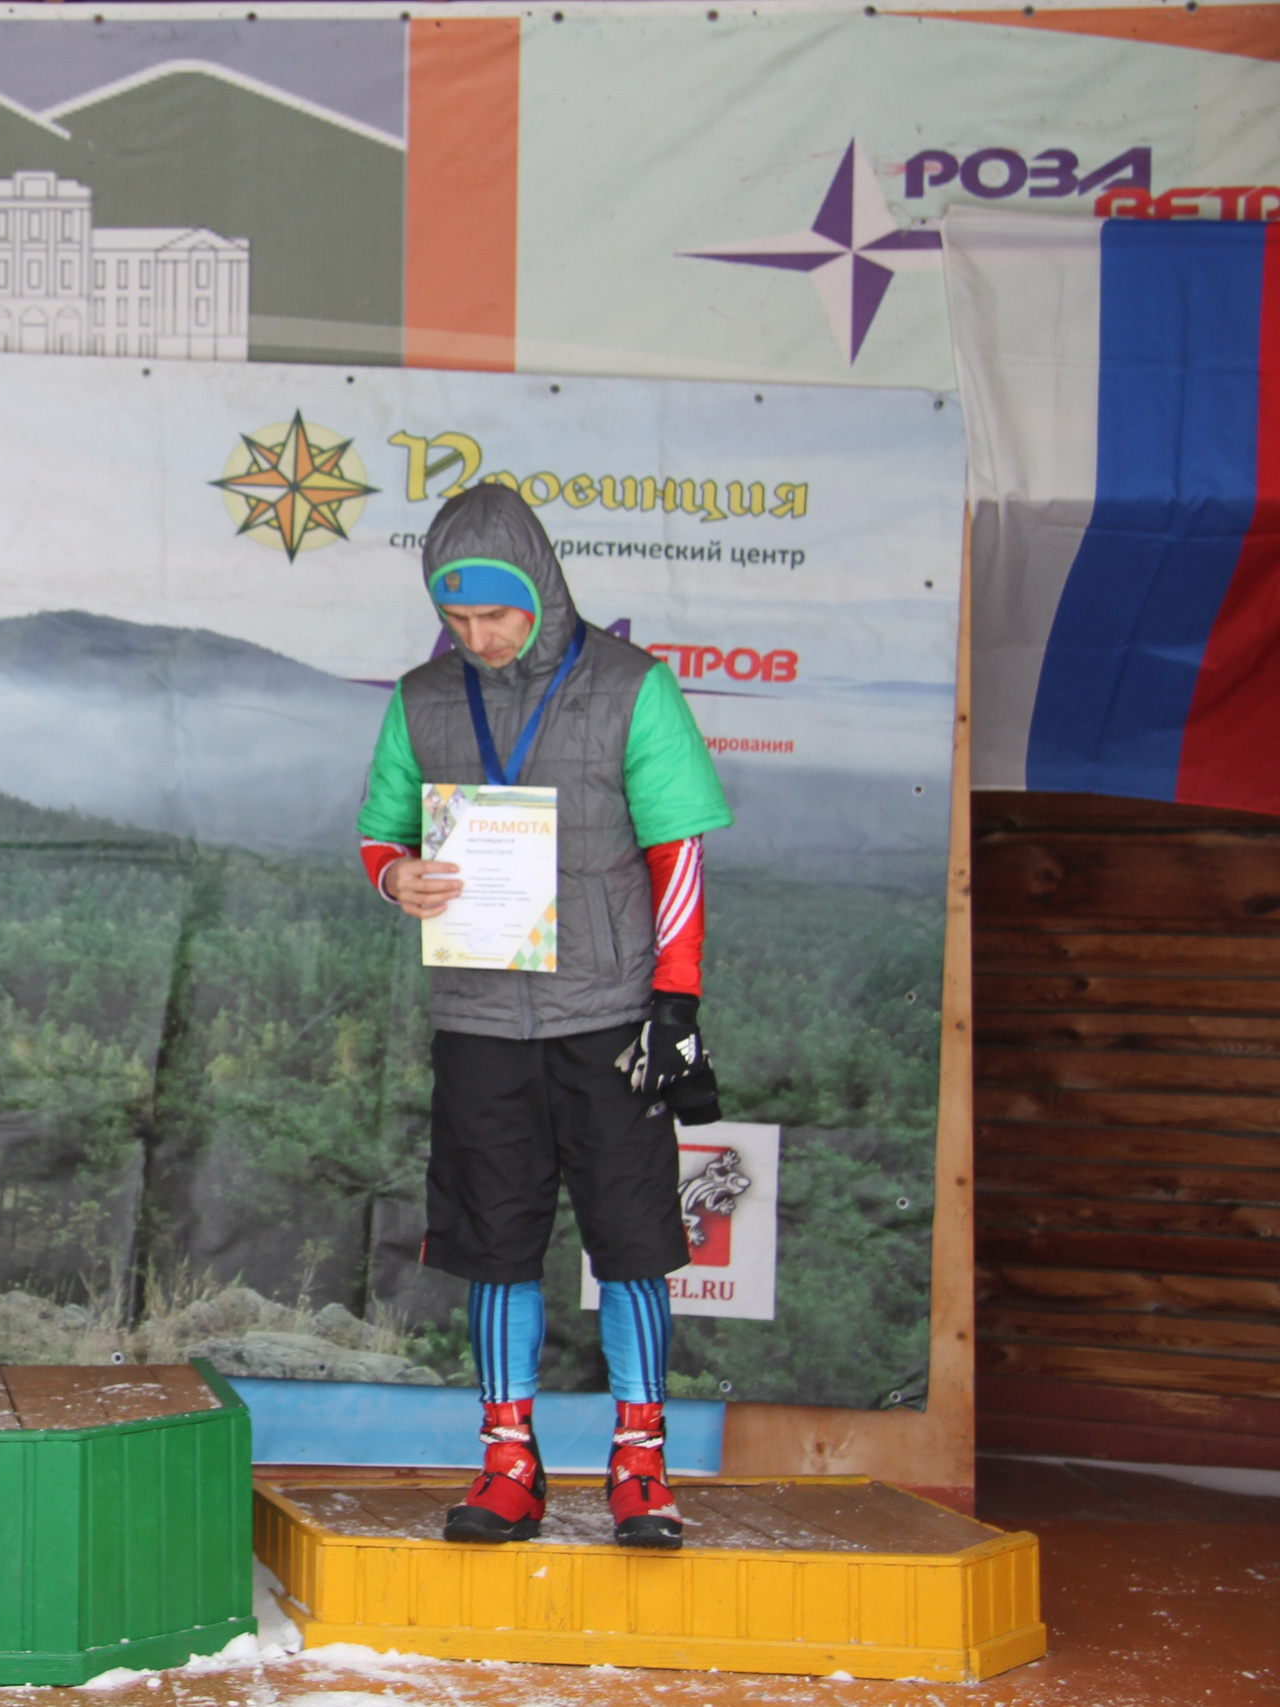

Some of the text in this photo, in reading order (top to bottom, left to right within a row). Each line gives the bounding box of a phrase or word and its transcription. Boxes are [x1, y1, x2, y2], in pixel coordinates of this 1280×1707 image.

[905, 147, 1152, 199] РОЗА
[731, 546, 805, 570] центр
[703, 736, 795, 755] ирования
[469, 819, 551, 835] ГРАМОТА
[666, 1278, 735, 1301] EL.RU
